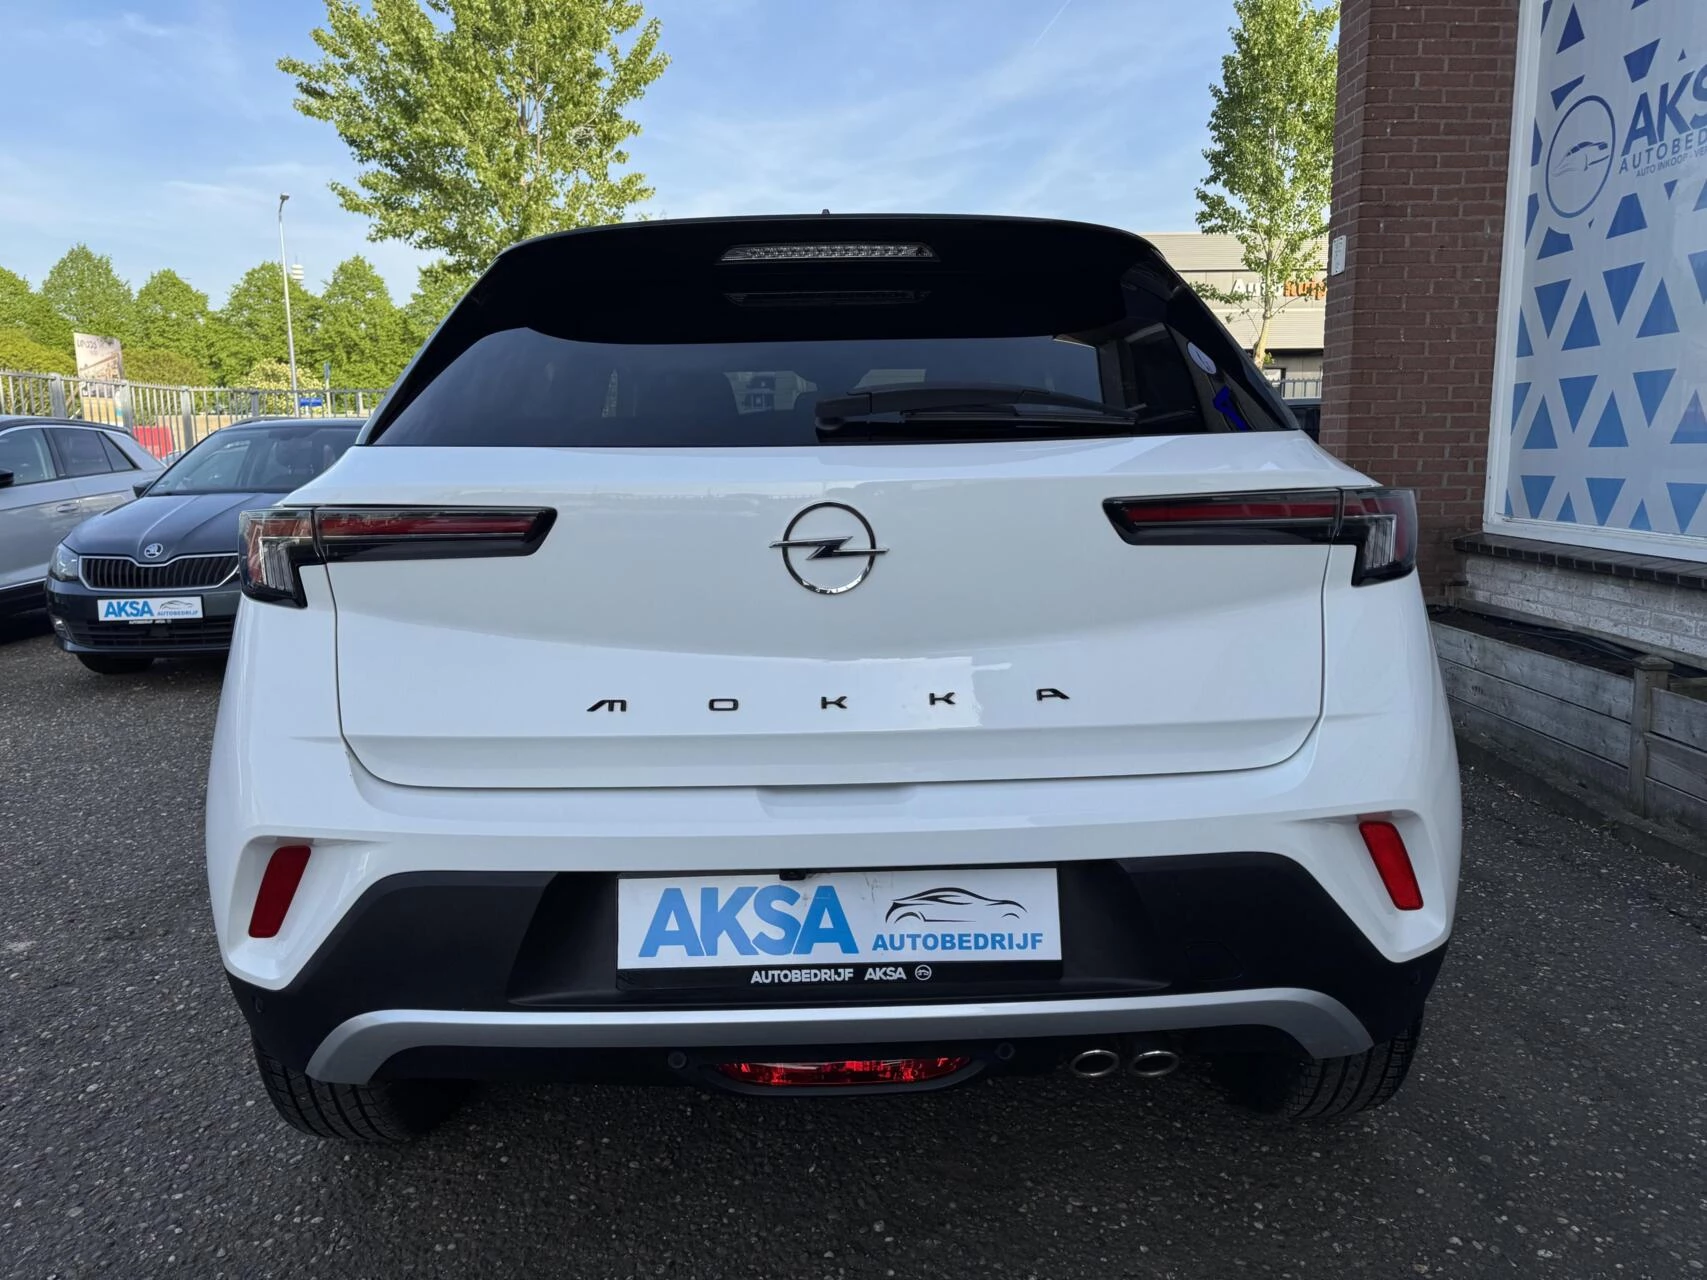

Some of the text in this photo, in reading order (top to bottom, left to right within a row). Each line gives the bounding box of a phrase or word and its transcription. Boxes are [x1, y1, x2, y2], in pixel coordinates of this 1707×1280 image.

[104, 600, 154, 618] AKSA
[586, 687, 1071, 713] MOKKA
[637, 885, 1044, 959] AKSA AUTOBEDRIJF
[750, 967, 907, 984] AUTOBEDRIJF AKSA
